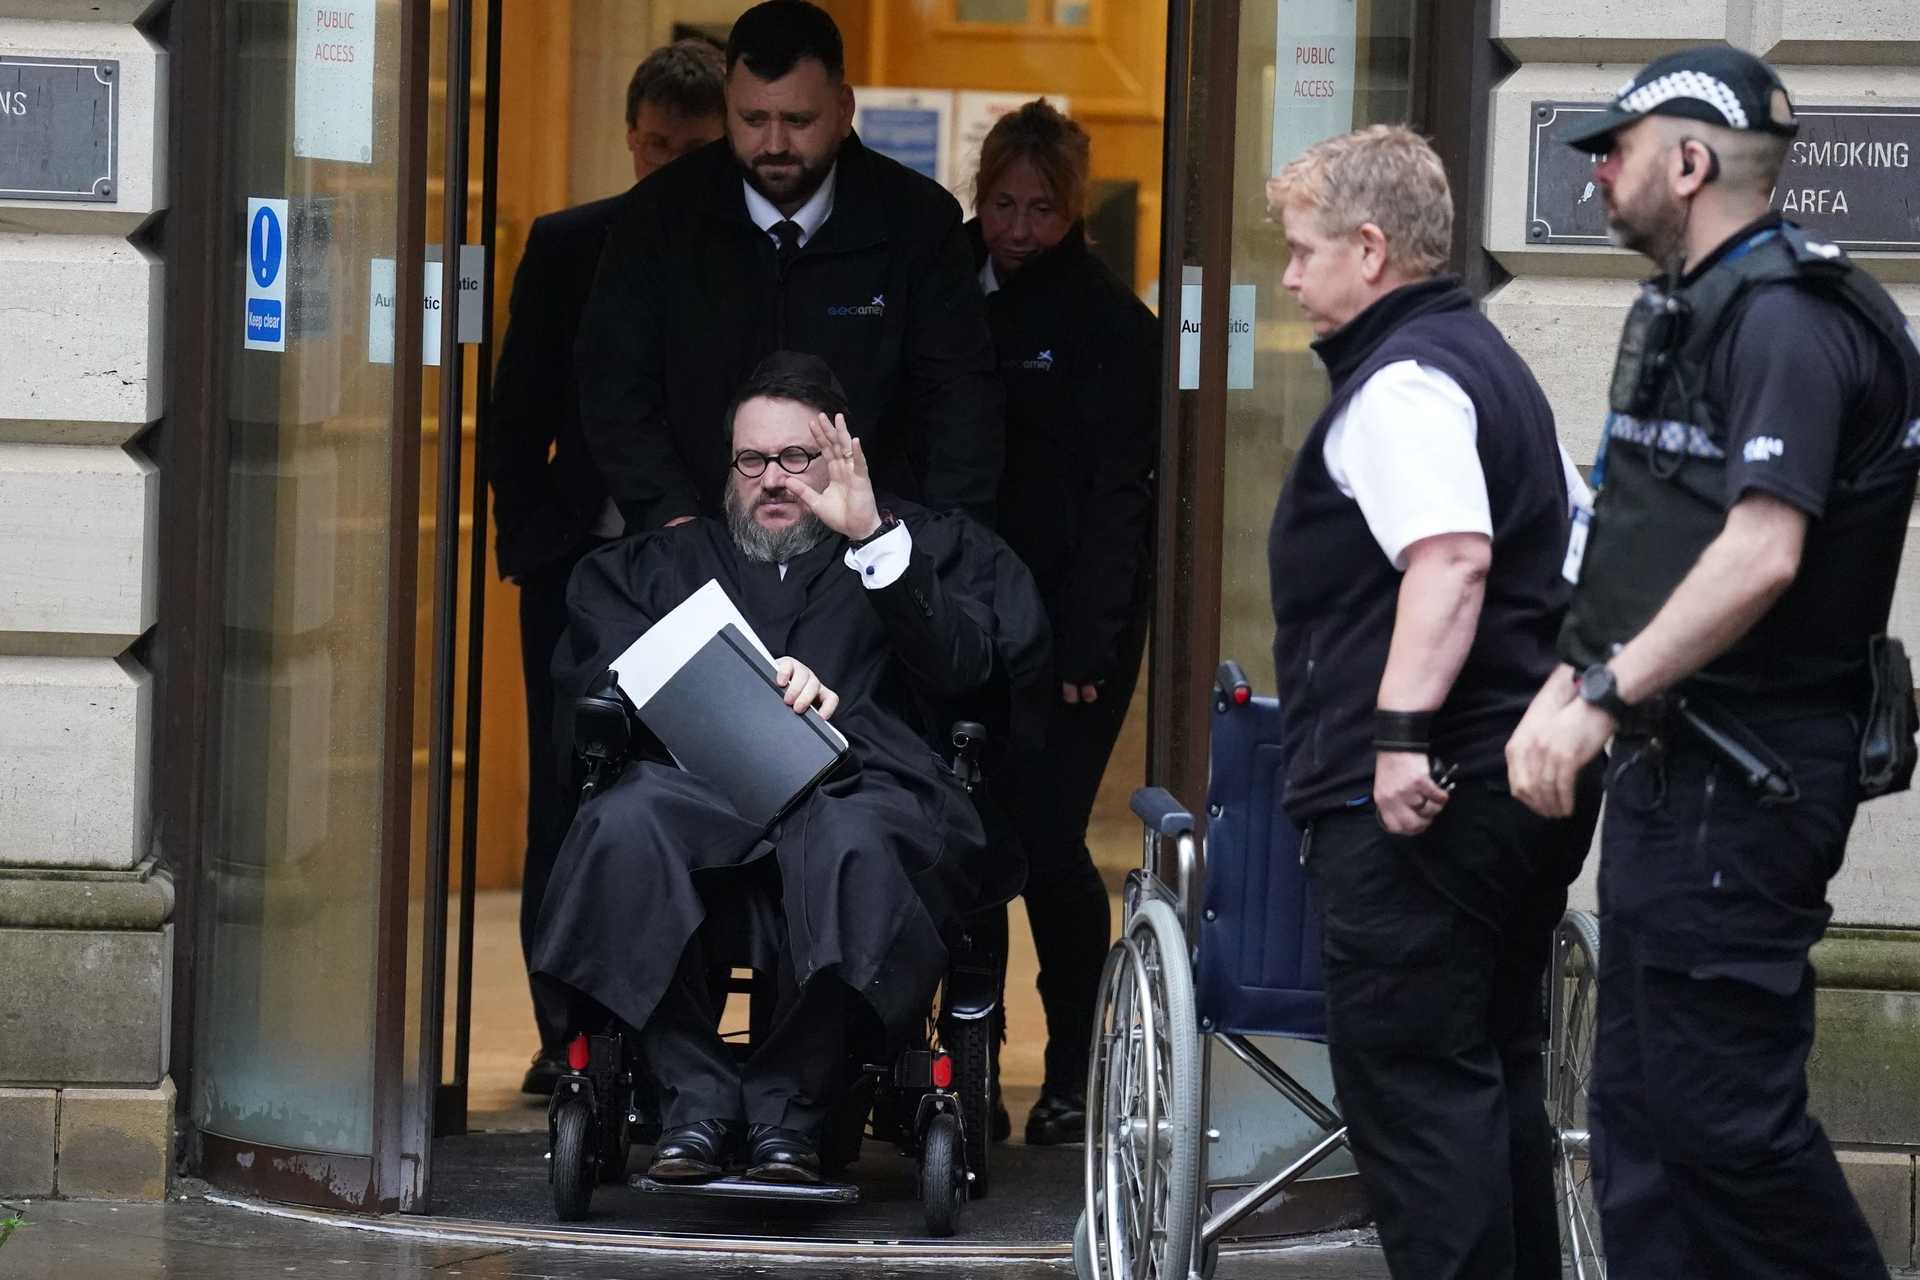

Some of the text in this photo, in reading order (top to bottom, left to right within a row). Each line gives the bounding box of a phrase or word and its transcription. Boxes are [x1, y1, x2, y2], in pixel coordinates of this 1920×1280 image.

[317, 10, 354, 29] PUBLIC
[315, 43, 354, 62] ACCESS
[1296, 47, 1335, 64] PUBLIC
[1294, 80, 1334, 97] ACCESS
[1792, 141, 1909, 168] SMOKING
[1782, 189, 1849, 214] AREA
[249, 312, 280, 330] Keep clear
